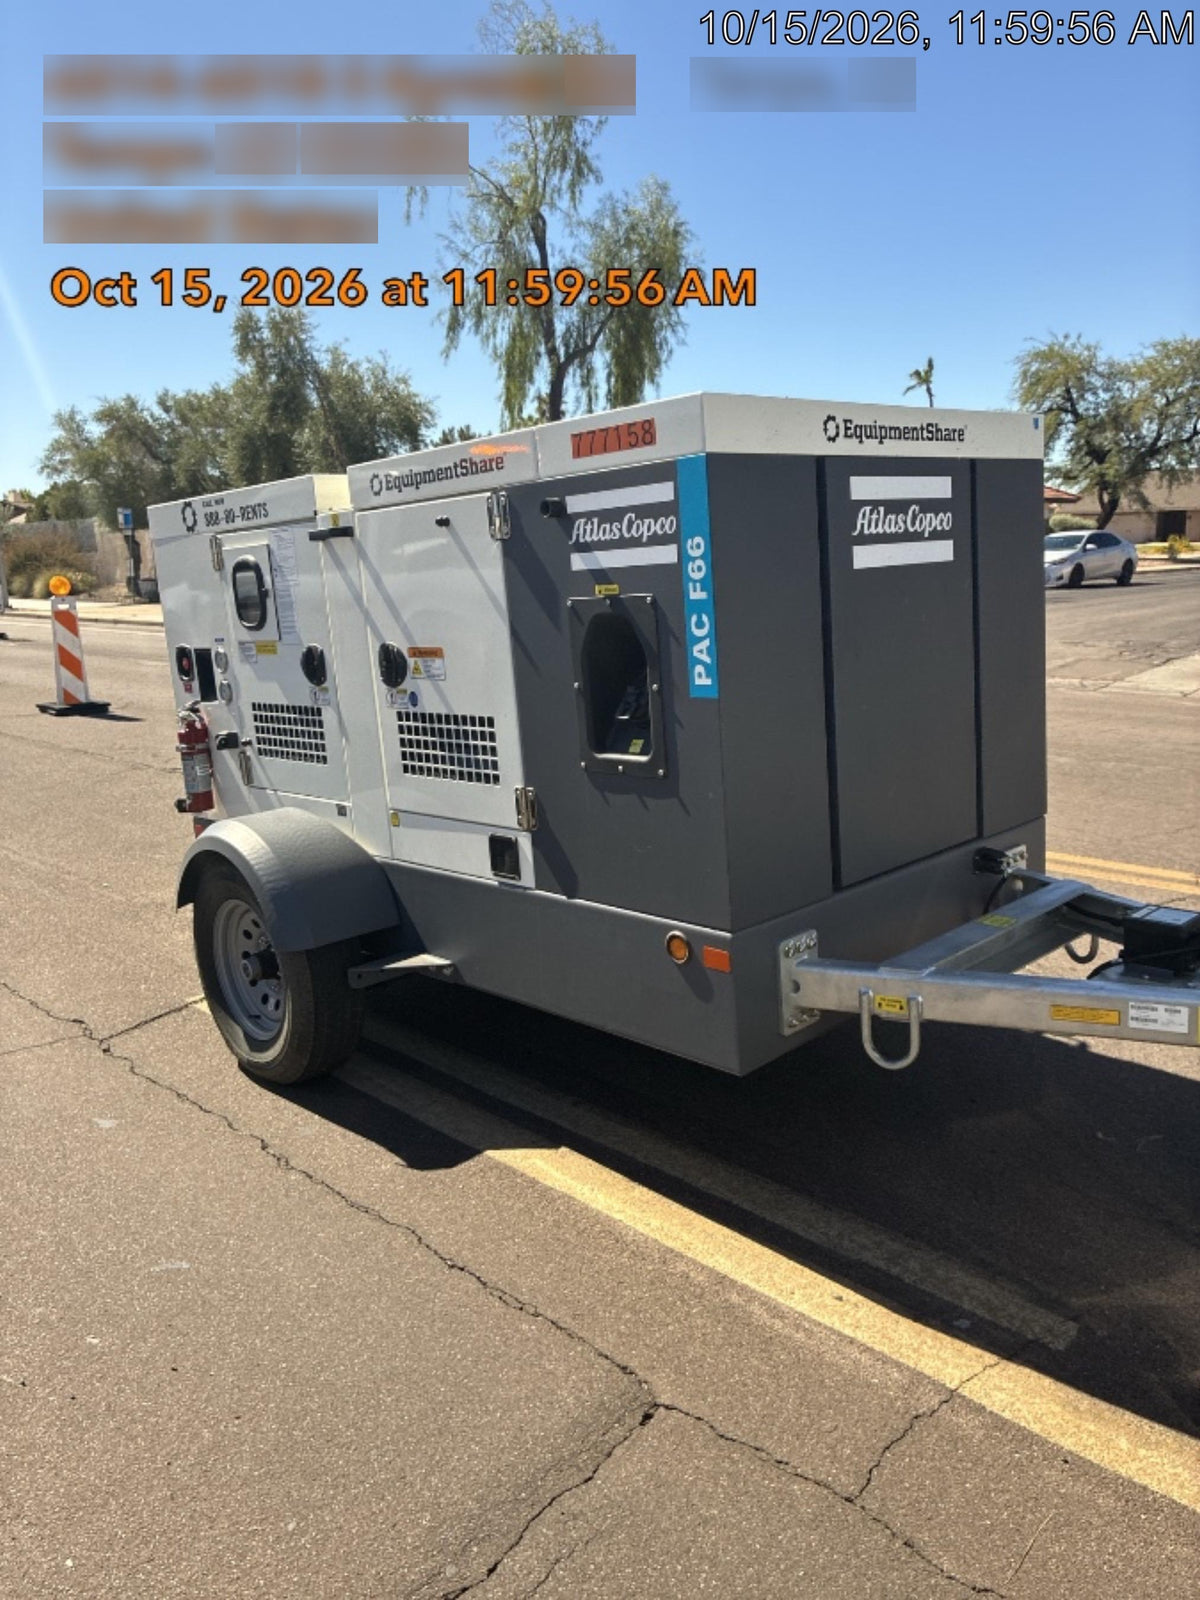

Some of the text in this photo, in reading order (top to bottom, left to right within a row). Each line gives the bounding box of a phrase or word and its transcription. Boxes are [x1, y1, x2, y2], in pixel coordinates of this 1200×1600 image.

[571, 419, 654, 459] 777158
[843, 418, 965, 445] EquipmentShare
[384, 455, 505, 493] EquipmentShare
[685, 535, 713, 687] PAC F66
